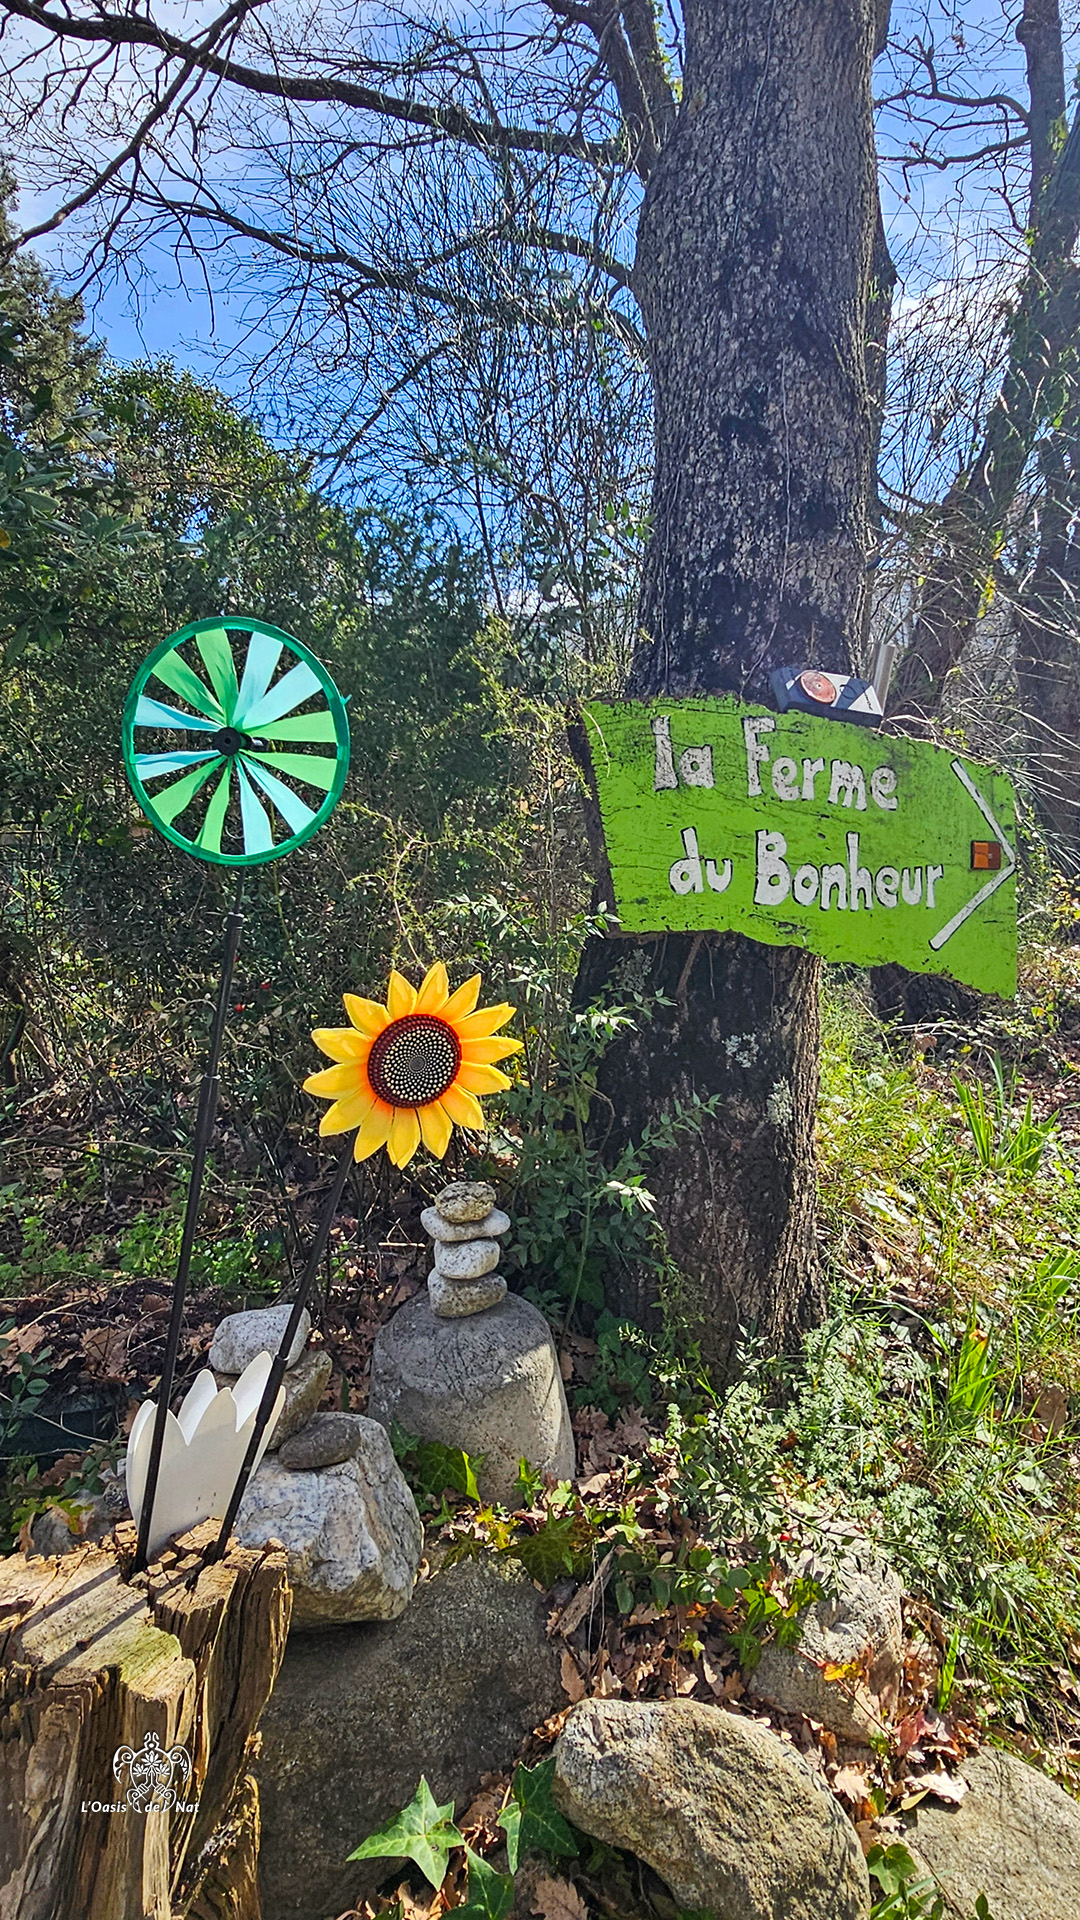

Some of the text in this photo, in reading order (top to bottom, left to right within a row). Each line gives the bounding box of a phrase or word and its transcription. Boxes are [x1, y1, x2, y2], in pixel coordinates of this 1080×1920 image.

[650, 714, 899, 812] la Ferme
[668, 826, 944, 912] du Bonheur
